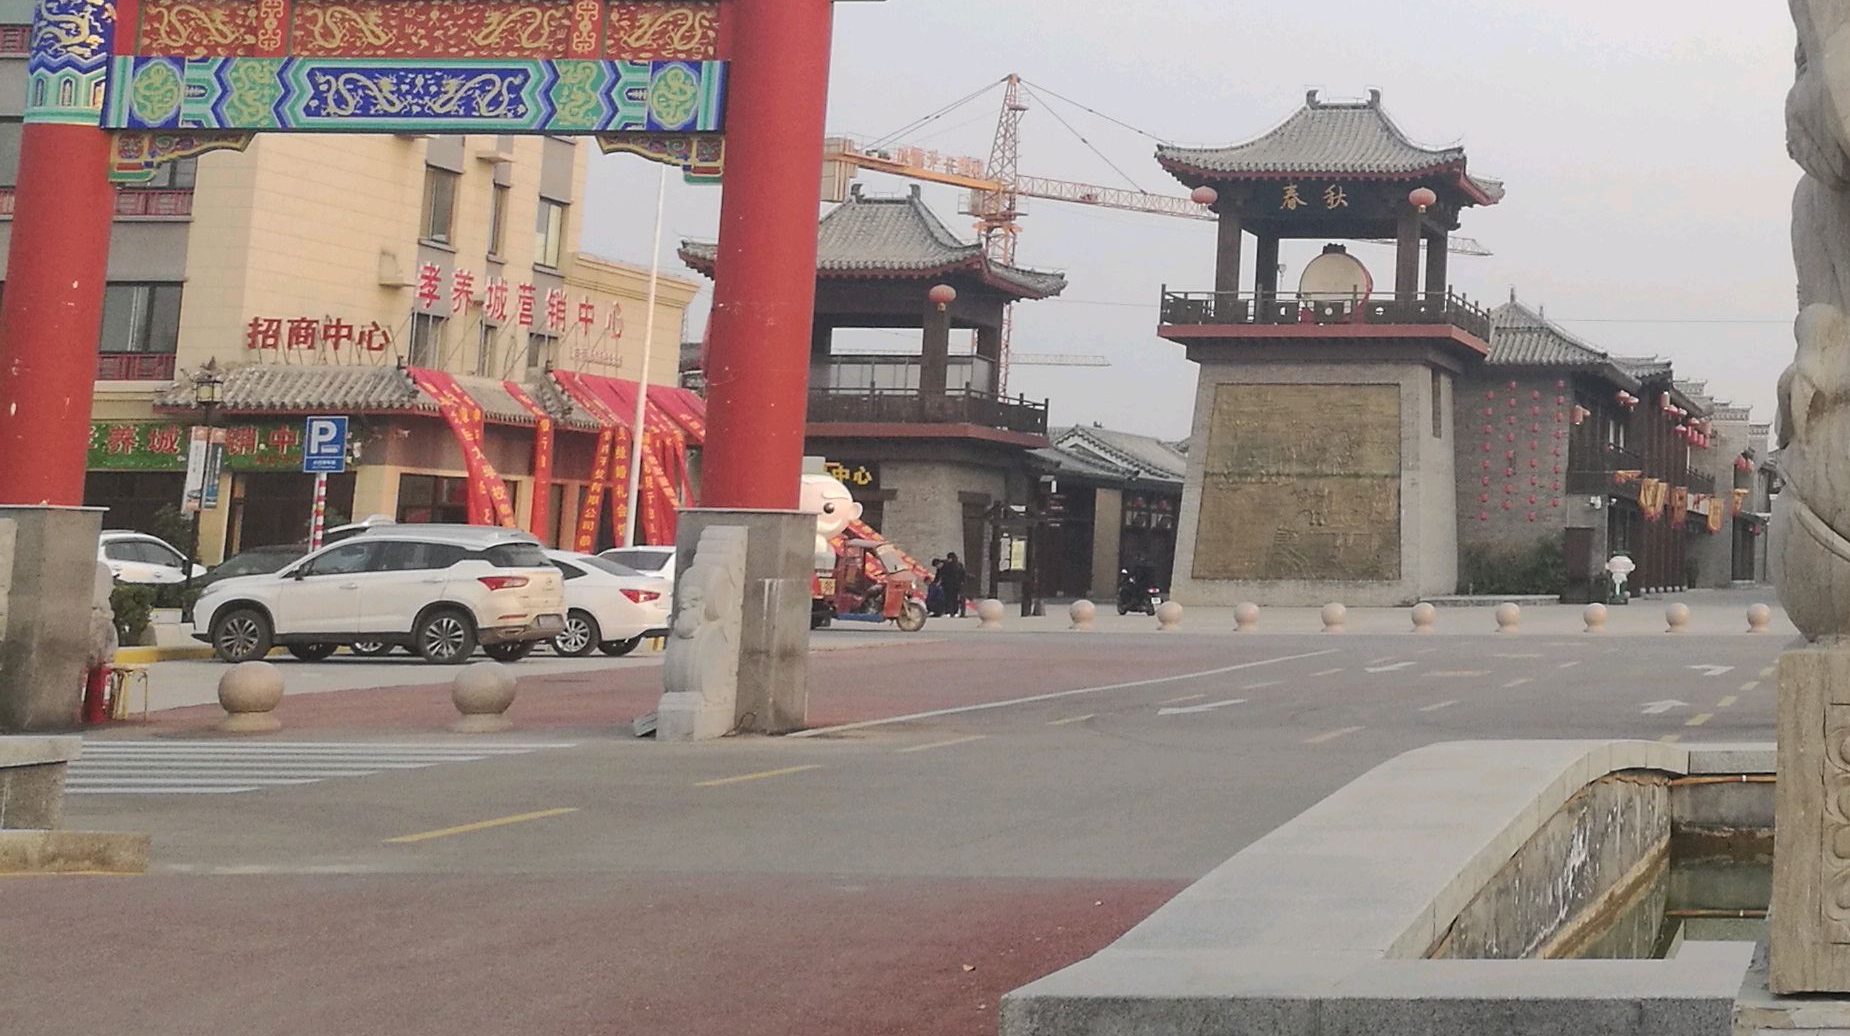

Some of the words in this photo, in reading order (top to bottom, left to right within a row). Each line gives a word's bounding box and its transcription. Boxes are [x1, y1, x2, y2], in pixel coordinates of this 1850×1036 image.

[1280, 183, 1348, 210] 春秋
[416, 262, 624, 340] 孝养城营销中心
[247, 316, 391, 352] 招商中心
[310, 421, 337, 454] P
